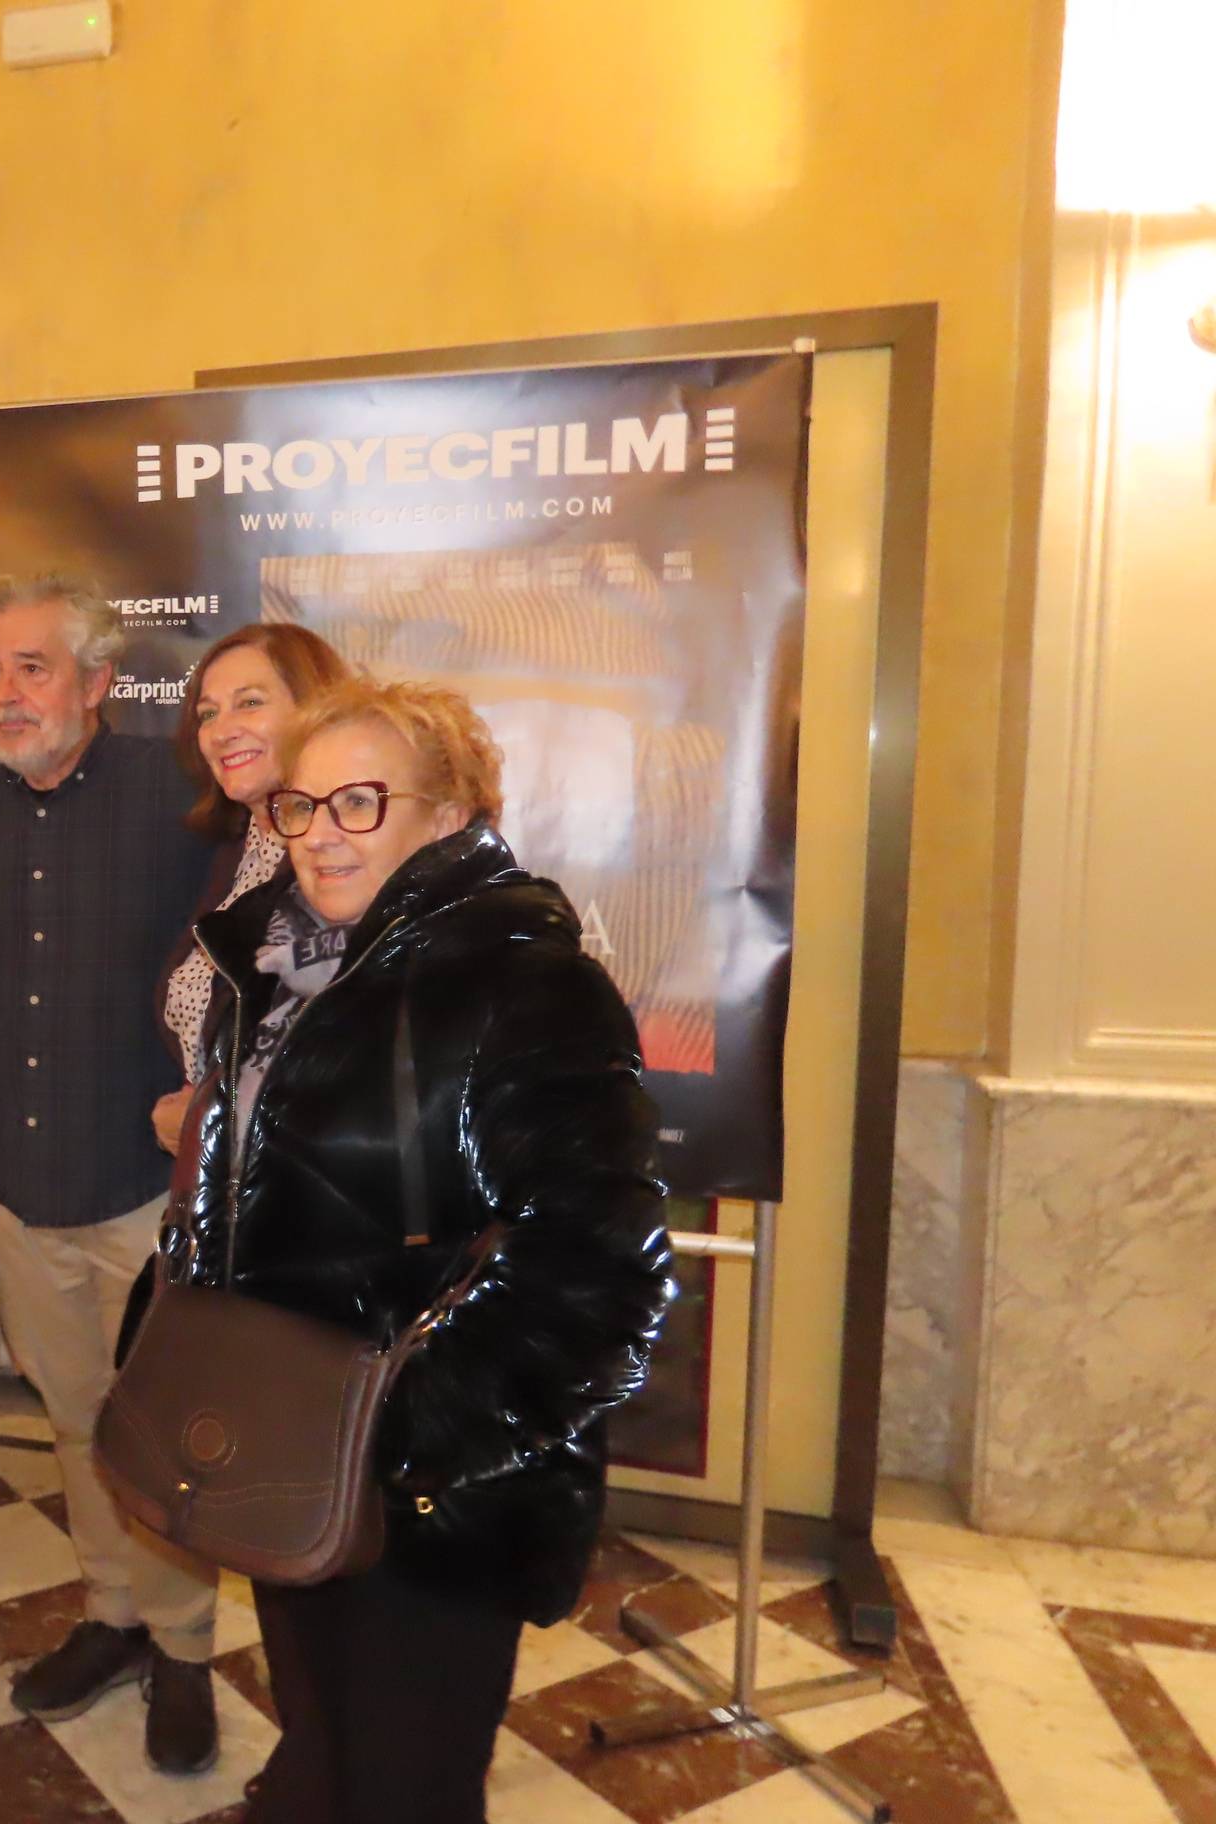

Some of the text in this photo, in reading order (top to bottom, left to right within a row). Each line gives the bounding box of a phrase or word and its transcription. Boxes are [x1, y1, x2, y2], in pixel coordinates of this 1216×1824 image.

[175, 412, 688, 500] PROYECFILM
[240, 496, 614, 533] WWW.PROYECFILM.COM
[106, 595, 206, 615] YECFILM
[124, 618, 187, 627] YECFILM.COM
[109, 677, 186, 703] carprint
[582, 899, 616, 956] A
